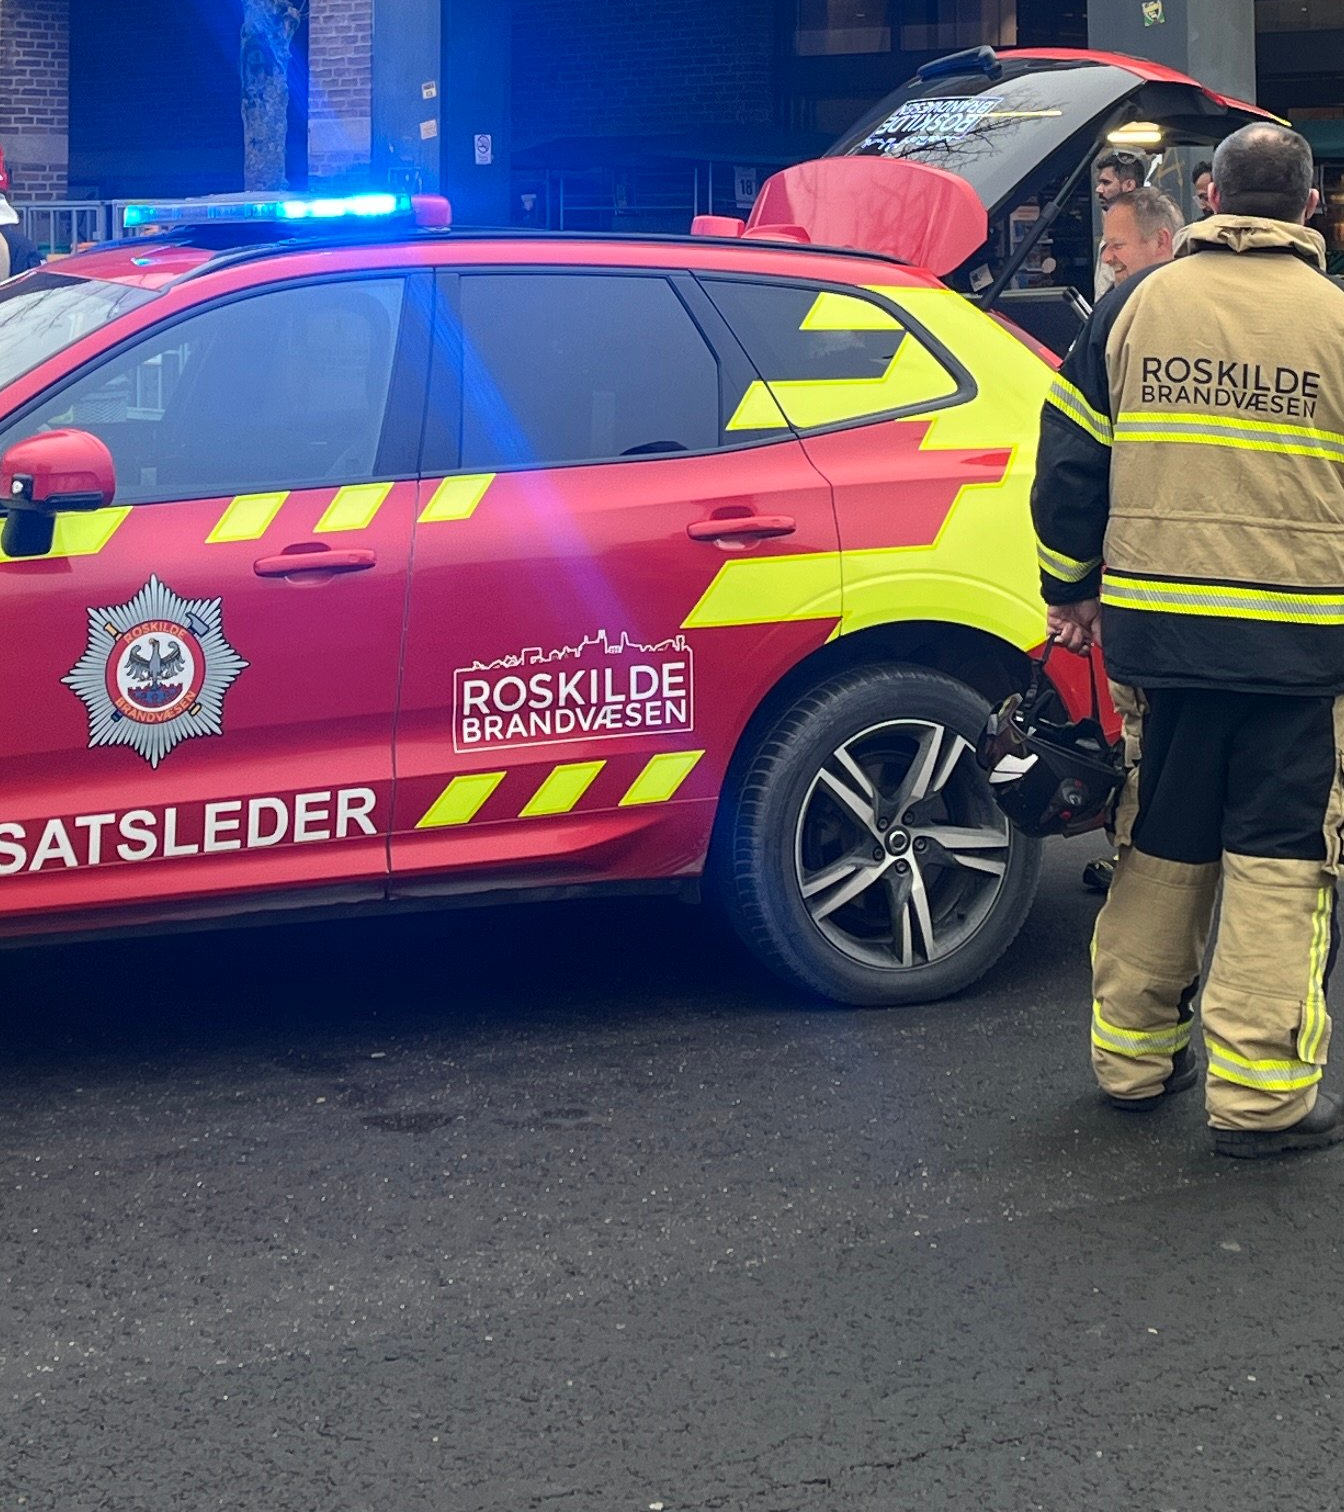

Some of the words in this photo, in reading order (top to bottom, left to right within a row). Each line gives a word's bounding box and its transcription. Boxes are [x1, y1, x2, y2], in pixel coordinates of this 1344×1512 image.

[1142, 356, 1321, 399] ROSKILDE
[1141, 384, 1317, 419] BRANDVÆSEN
[123, 622, 187, 645] ROSKILDE
[114, 691, 197, 723] BRANDVÆSEN
[462, 661, 687, 715] ROSKILDE
[461, 699, 688, 745] BRANDVÆSEN
